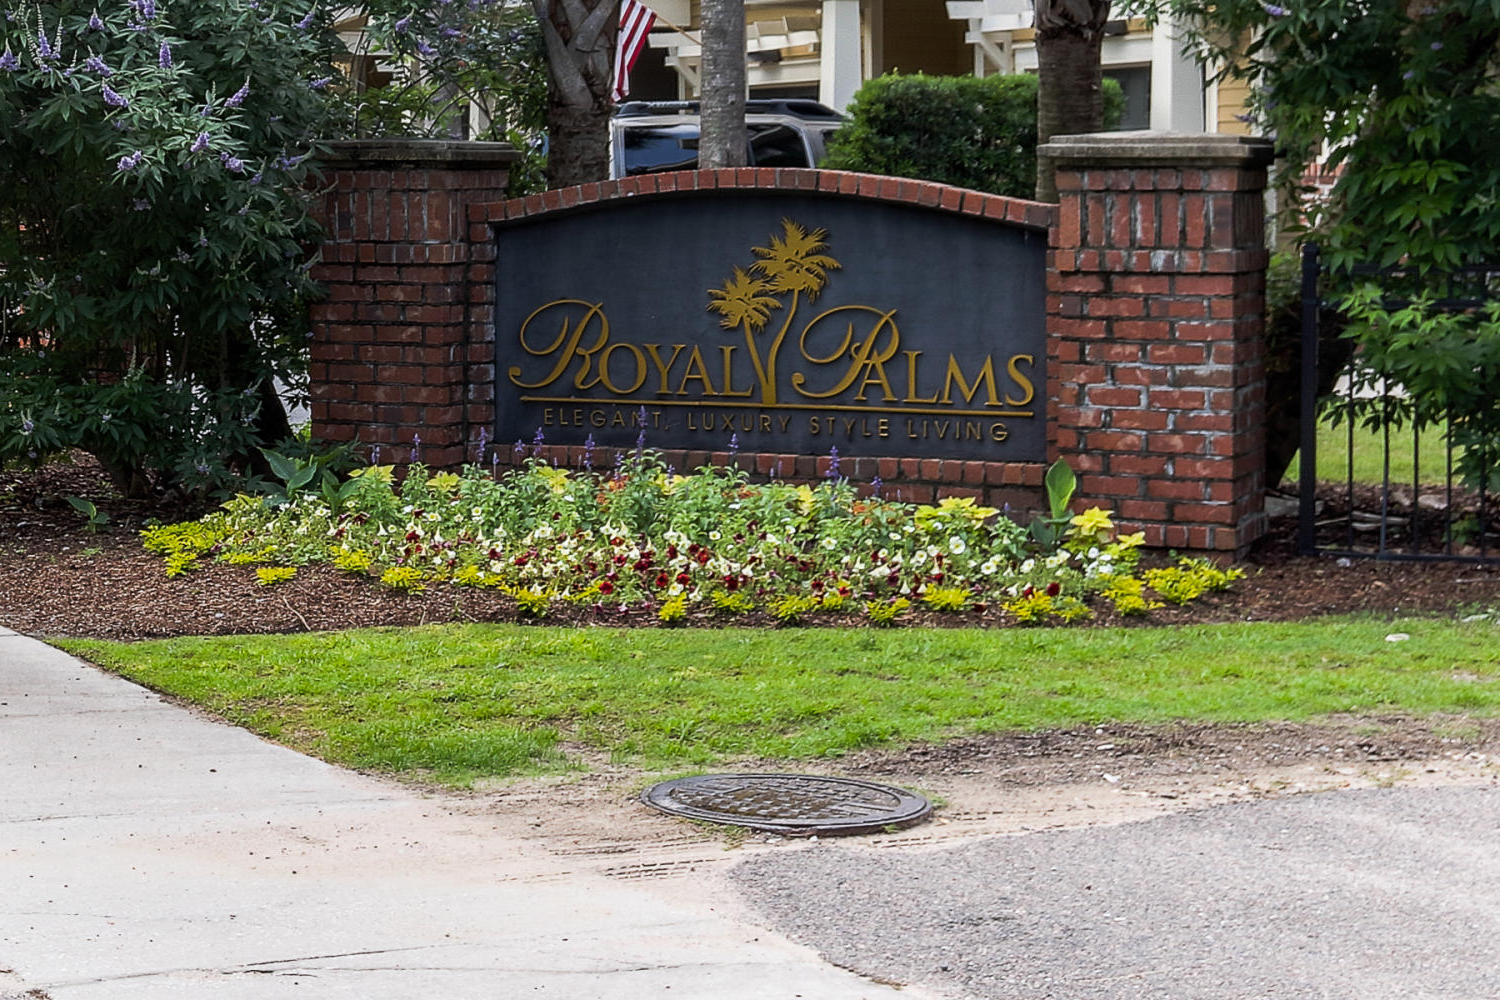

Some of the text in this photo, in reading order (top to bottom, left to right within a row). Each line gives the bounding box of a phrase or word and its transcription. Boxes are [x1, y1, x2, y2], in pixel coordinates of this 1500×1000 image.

[508, 299, 1034, 406] ROYAL PALMS
[687, 412, 791, 432] LUXURY
[809, 415, 889, 437] STYLE
[907, 419, 1008, 441] LIVING
